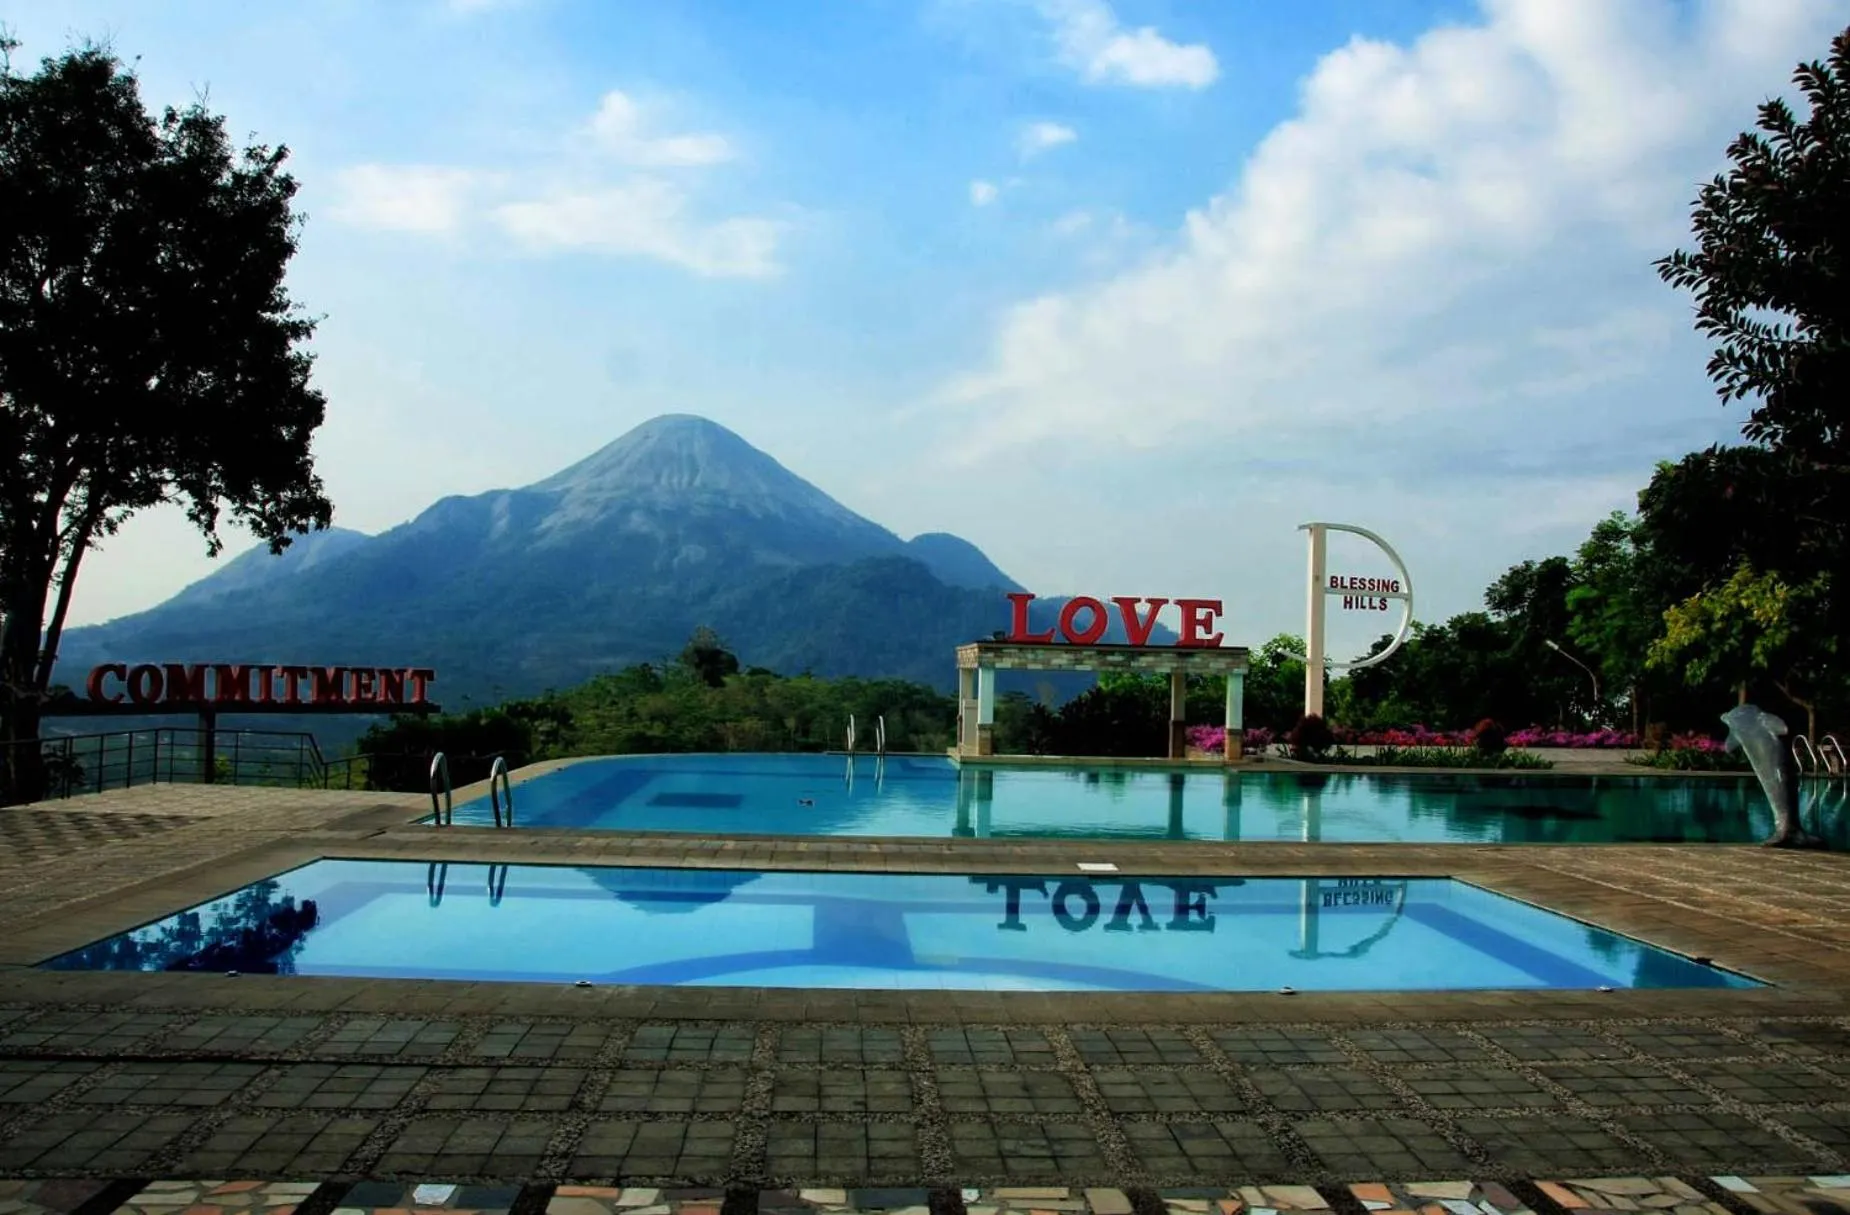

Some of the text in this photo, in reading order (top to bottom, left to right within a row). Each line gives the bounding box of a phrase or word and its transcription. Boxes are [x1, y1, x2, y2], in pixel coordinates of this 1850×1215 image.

[1330, 576, 1399, 592] BLESSING
[1344, 596, 1387, 610] HILLS
[1007, 593, 1224, 647] LOVE
[87, 664, 434, 705] COMMITMENT
